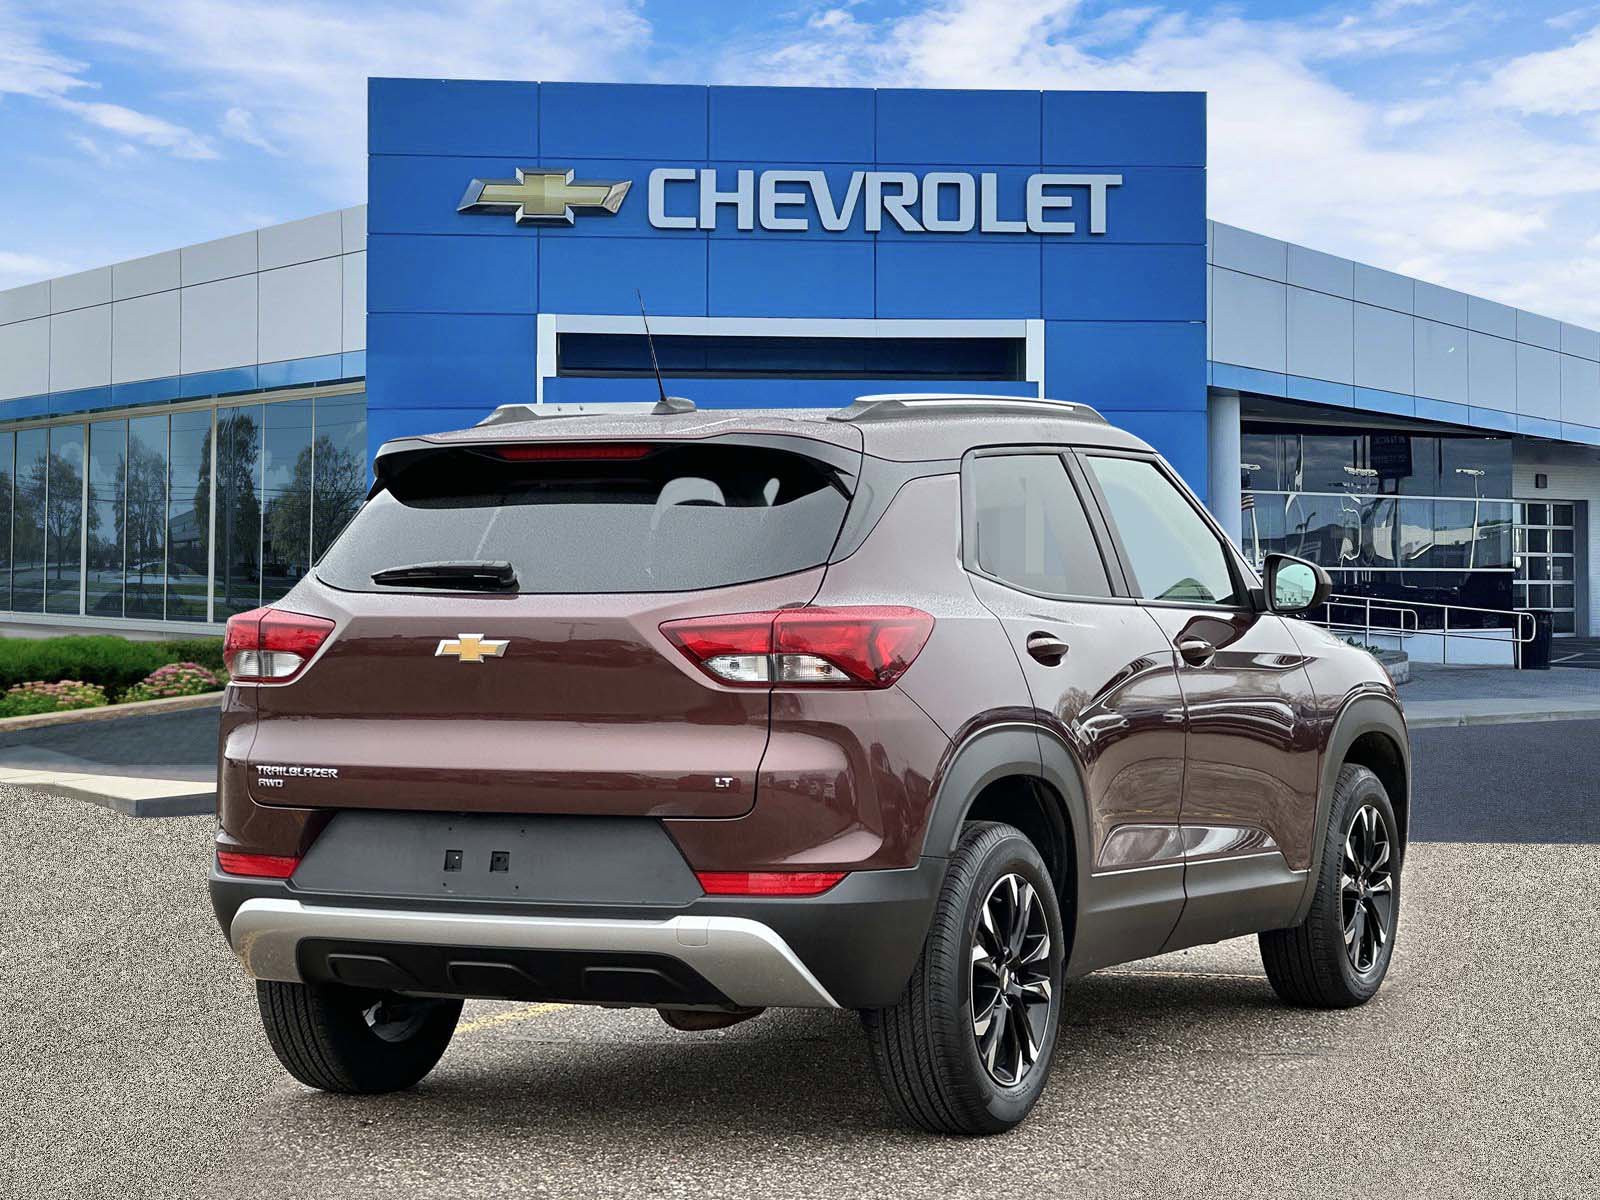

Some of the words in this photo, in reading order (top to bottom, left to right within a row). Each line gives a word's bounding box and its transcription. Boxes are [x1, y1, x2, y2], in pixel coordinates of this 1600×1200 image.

[648, 168, 1123, 234] CHEVROLET
[256, 765, 338, 778] TRAILBLAZER
[258, 778, 283, 787] AWD
[715, 777, 733, 787] LT
